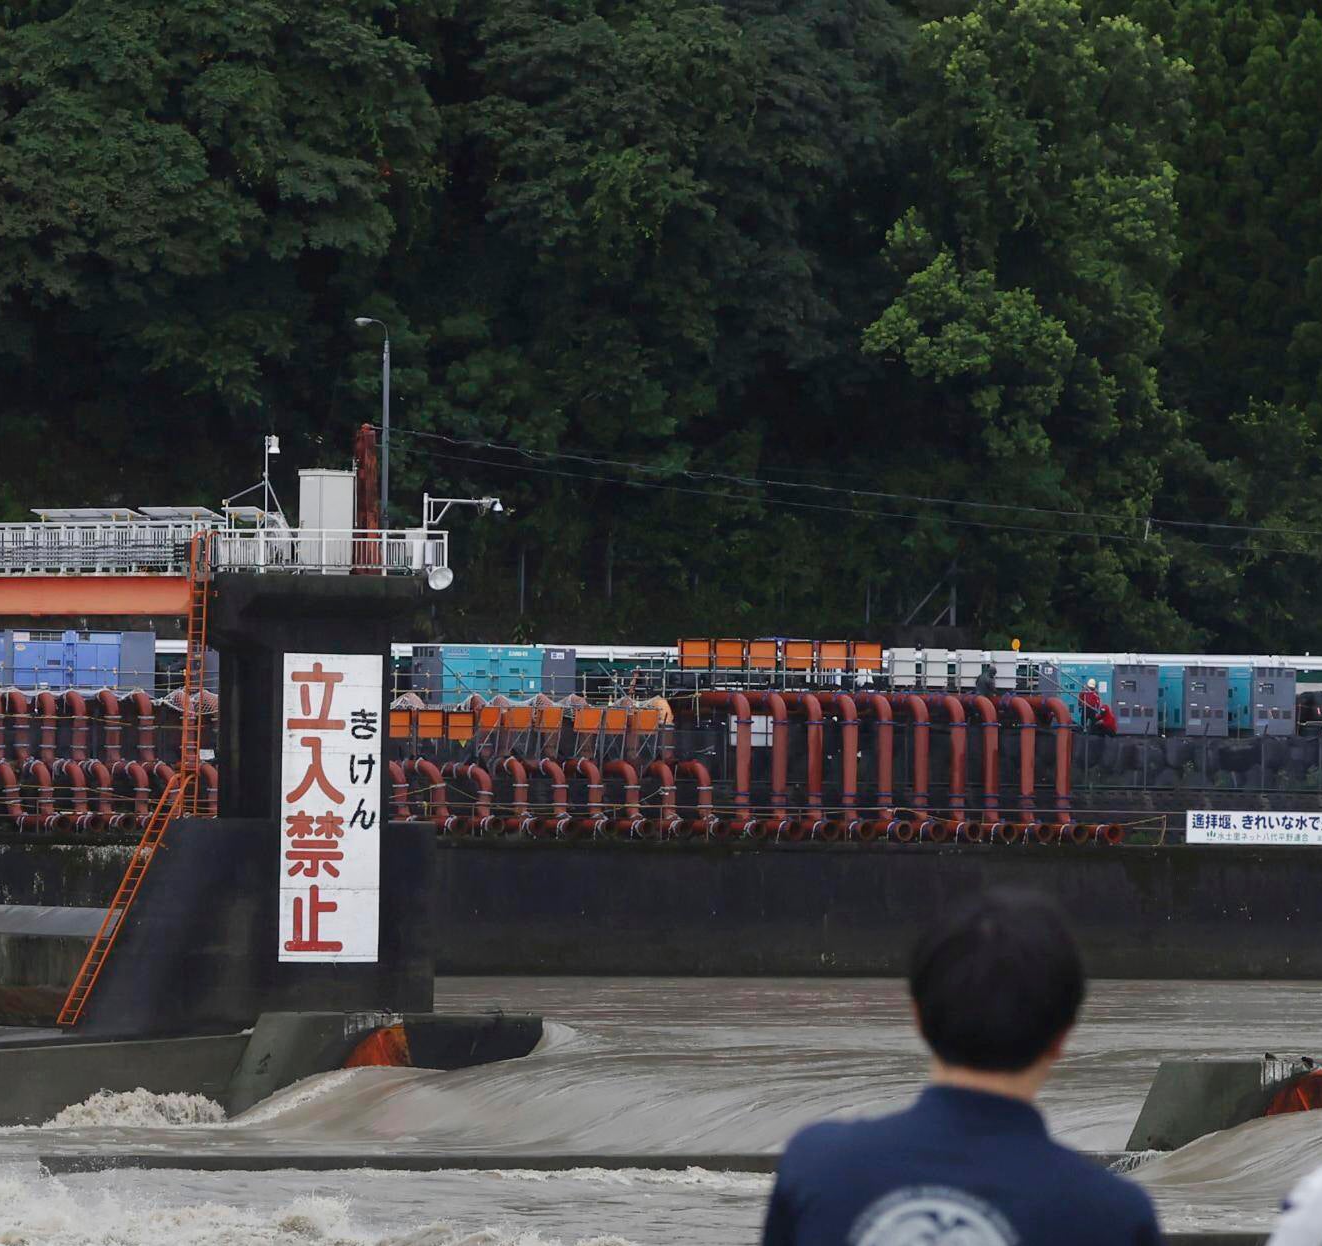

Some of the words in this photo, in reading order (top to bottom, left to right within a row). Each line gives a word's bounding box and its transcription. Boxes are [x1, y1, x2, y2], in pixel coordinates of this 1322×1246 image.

[284, 662, 346, 951] 立入禁止
[349, 709, 378, 830] きけん
